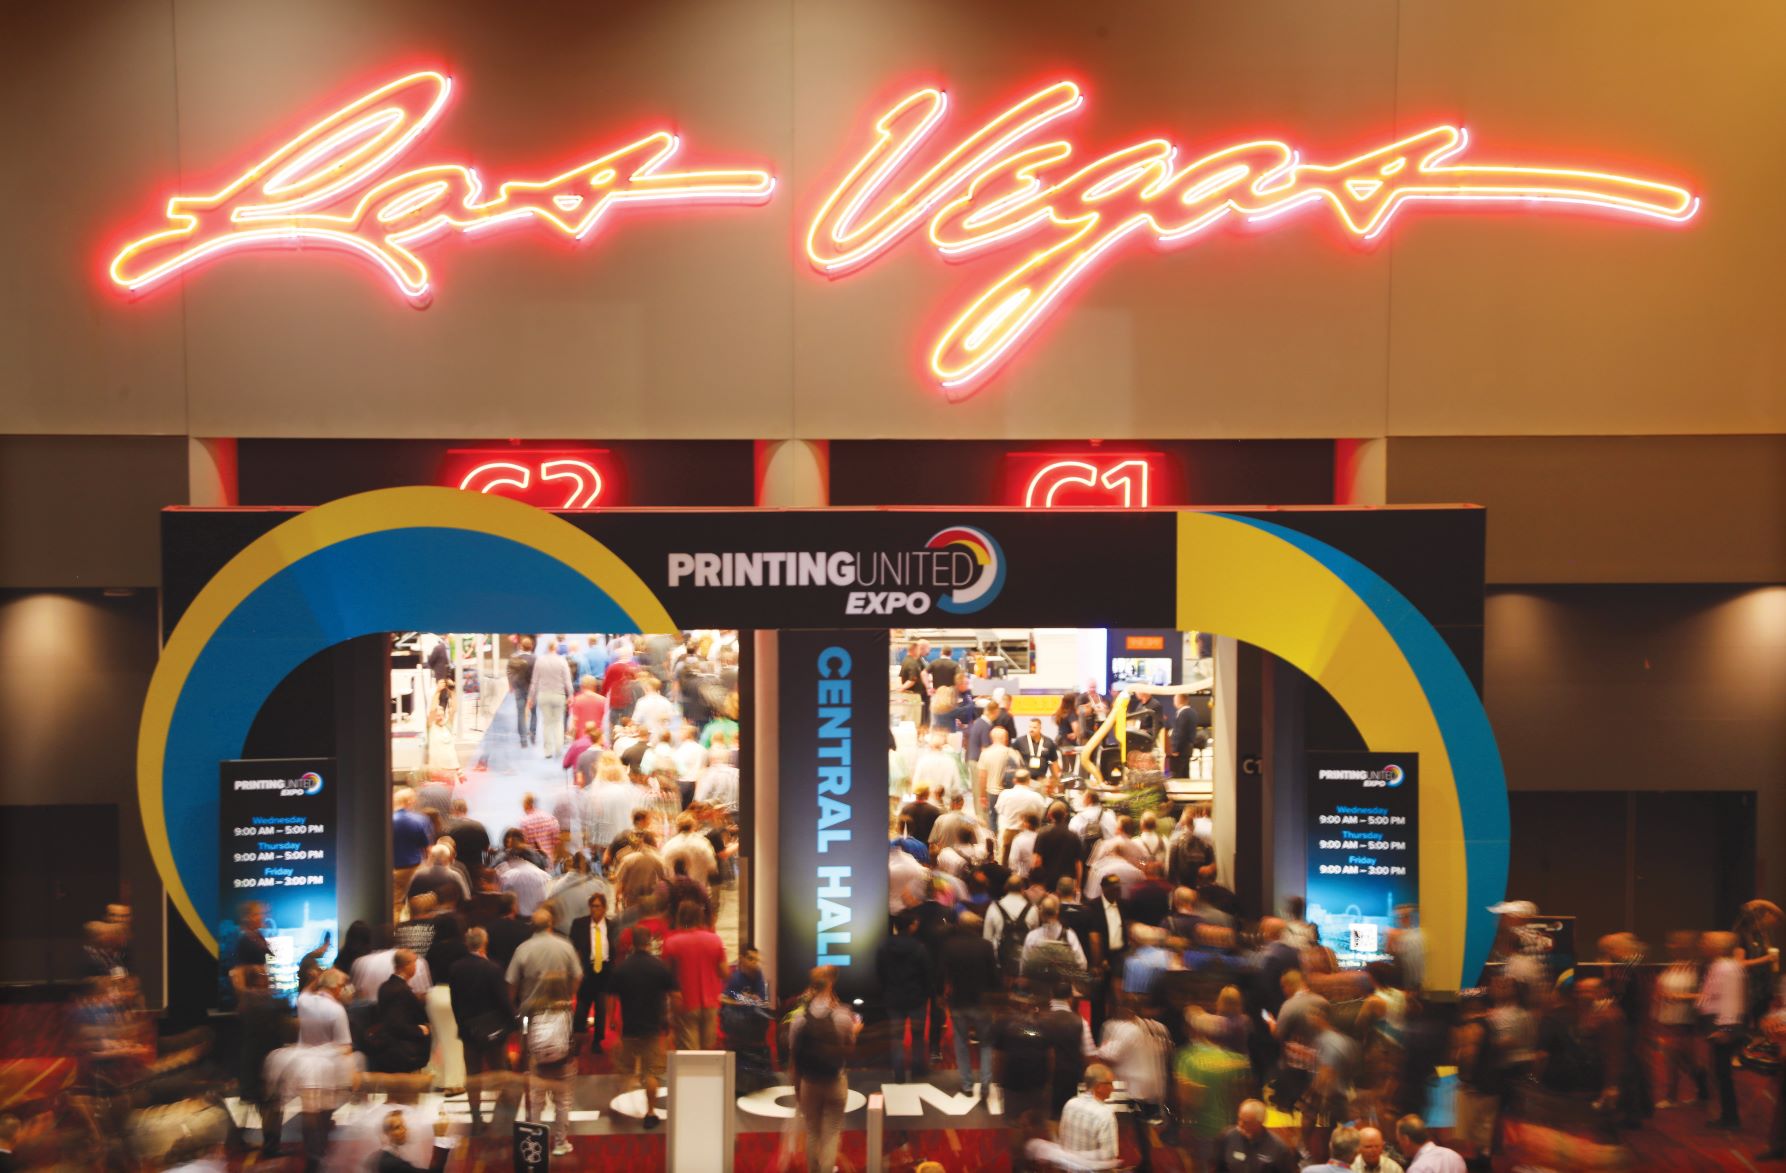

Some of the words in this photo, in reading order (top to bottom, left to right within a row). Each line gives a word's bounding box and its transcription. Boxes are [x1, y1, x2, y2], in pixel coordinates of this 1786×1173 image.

[109, 71, 776, 297] Las
[807, 80, 1700, 387] Vegas
[845, 592, 932, 616] EXPO
[817, 646, 852, 853] CENTRAL
[1319, 815, 1341, 824] 9:00
[1341, 815, 1358, 824] AM
[1367, 815, 1389, 825] 5:00
[1390, 816, 1406, 825] PM
[233, 826, 257, 836] 9:00
[257, 826, 275, 835] AM
[284, 824, 307, 834] 5:00
[307, 824, 324, 833] PM
[1342, 830, 1384, 840] Thursday
[257, 842, 300, 850] Thursday
[1319, 840, 1341, 849] 9:00
[1341, 840, 1358, 849] AM
[1367, 840, 1389, 850] 5:00
[1390, 841, 1406, 850] PM
[233, 853, 257, 862] 9:00
[257, 851, 275, 861] AM
[284, 850, 307, 860] 5:00
[307, 850, 324, 859] PM
[1348, 855, 1377, 866] Friday
[264, 867, 294, 876] Friday
[1319, 864, 1342, 875] 9:00
[1341, 865, 1359, 874] AM
[1390, 866, 1406, 875] PM
[233, 878, 257, 888] 9:00
[257, 877, 275, 887] AM
[307, 875, 324, 885] PM
